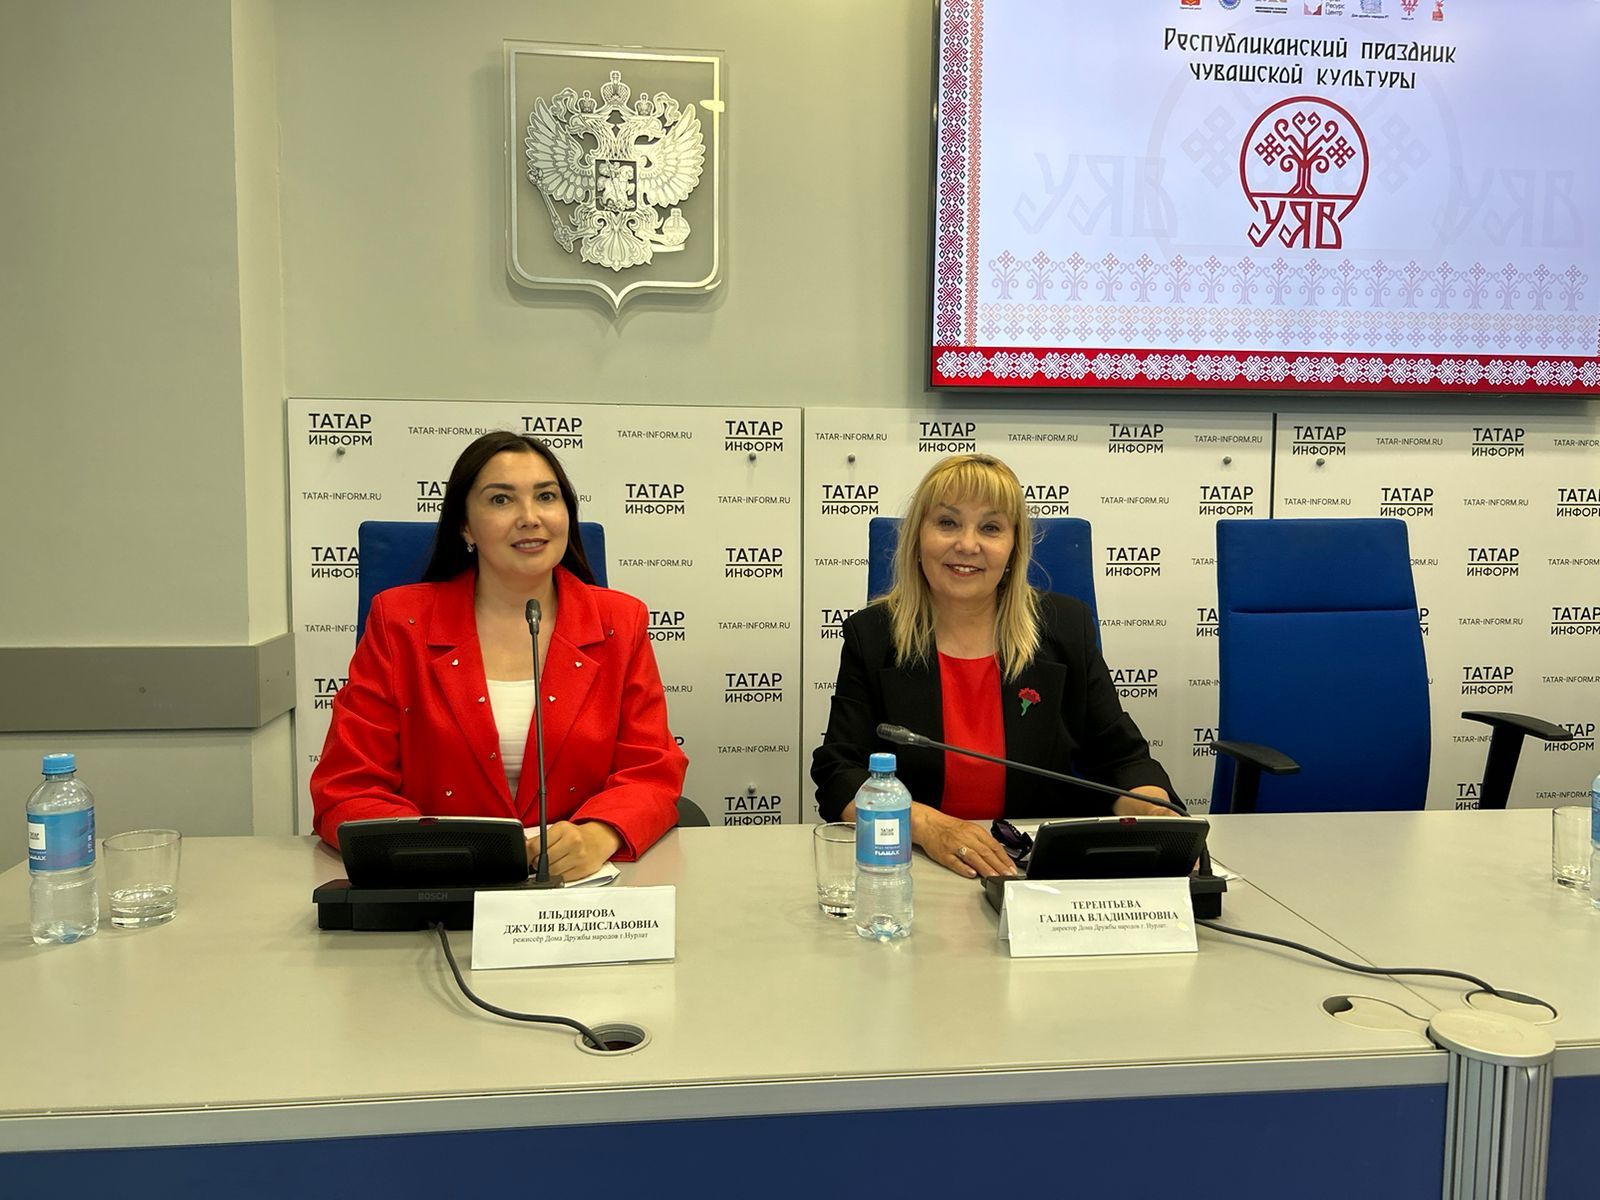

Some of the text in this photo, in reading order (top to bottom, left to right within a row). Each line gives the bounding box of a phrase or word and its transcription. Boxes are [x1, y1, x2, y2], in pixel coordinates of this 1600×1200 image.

[1164, 28, 1457, 63] Республиканский праздник
[1189, 62, 1416, 89] чувашской культуры
[1247, 199, 1343, 249] УЯВ
[309, 414, 371, 429] ТАТАР
[522, 417, 582, 432] ТАТАР
[408, 427, 488, 435] TATAR-INFORM.RU
[725, 421, 783, 435] ТАТАР
[920, 422, 976, 436] ТАТАР
[1294, 426, 1346, 440] ТАТАР
[618, 431, 692, 439] TATAR-INFORM.RU
[1195, 435, 1262, 443] TATAR-INFORM.RU
[1473, 428, 1524, 441] ТАТАР
[309, 435, 372, 445] ИНФОРМ
[540, 438, 583, 449] ФОРМ
[725, 441, 783, 451] ИНФОРМ
[919, 443, 975, 452] ИНФОРМ
[1109, 444, 1163, 453] ИНФОРМ
[1293, 446, 1345, 455] ИНФОРМ
[1472, 447, 1524, 456] ИНФОРМ
[302, 492, 381, 500] TATAR-INFORM.RU
[626, 484, 684, 498] ТАТАР
[822, 485, 878, 499] ТАТАР
[1021, 486, 1069, 500] АТАР
[1200, 486, 1253, 500] ТАТАР
[1381, 488, 1433, 501] ТАТАР
[626, 504, 684, 514] ИНФОРМ
[822, 505, 878, 514] ИНФОРМ
[1200, 506, 1253, 515] ИНФОРМ
[1381, 507, 1433, 516] ИНФОРМ
[1557, 507, 1600, 517] ИНФОР
[311, 547, 358, 562] ТАТА
[726, 548, 782, 562] ТАТАР
[1107, 548, 1160, 561] ТАТАР
[1468, 548, 1519, 561] ТАТАР
[726, 568, 782, 577] ИНФОРМ
[1106, 567, 1160, 576] ИНФОРМ
[1467, 567, 1518, 576] ИНФОРМ
[649, 611, 685, 626] ТАР
[305, 624, 356, 633] TATAR-INFO
[1463, 667, 1513, 680] ТАТАР
[726, 673, 782, 687] ТАТАР
[1462, 685, 1513, 694] ИНФОРМ
[725, 693, 782, 702] ИНФОРМ
[718, 745, 789, 753] TATAR-INFORM.RU
[1545, 742, 1594, 751] ИНФОРМ
[725, 796, 781, 810] ТАТАР
[418, 892, 448, 900] BOSCH
[1071, 900, 1141, 910] ТЕРЕНТЬЕВА
[538, 909, 616, 920] ИЛЬДИЯРОВА
[1039, 911, 1179, 923] ГАЛИНА ВЛАДИМИРОВНА
[503, 920, 659, 935] ДЖУЛИЯ ВЛАДИСЛАВОВНА
[512, 936, 544, 944] режиссёр
[564, 934, 591, 942] Дружбы
